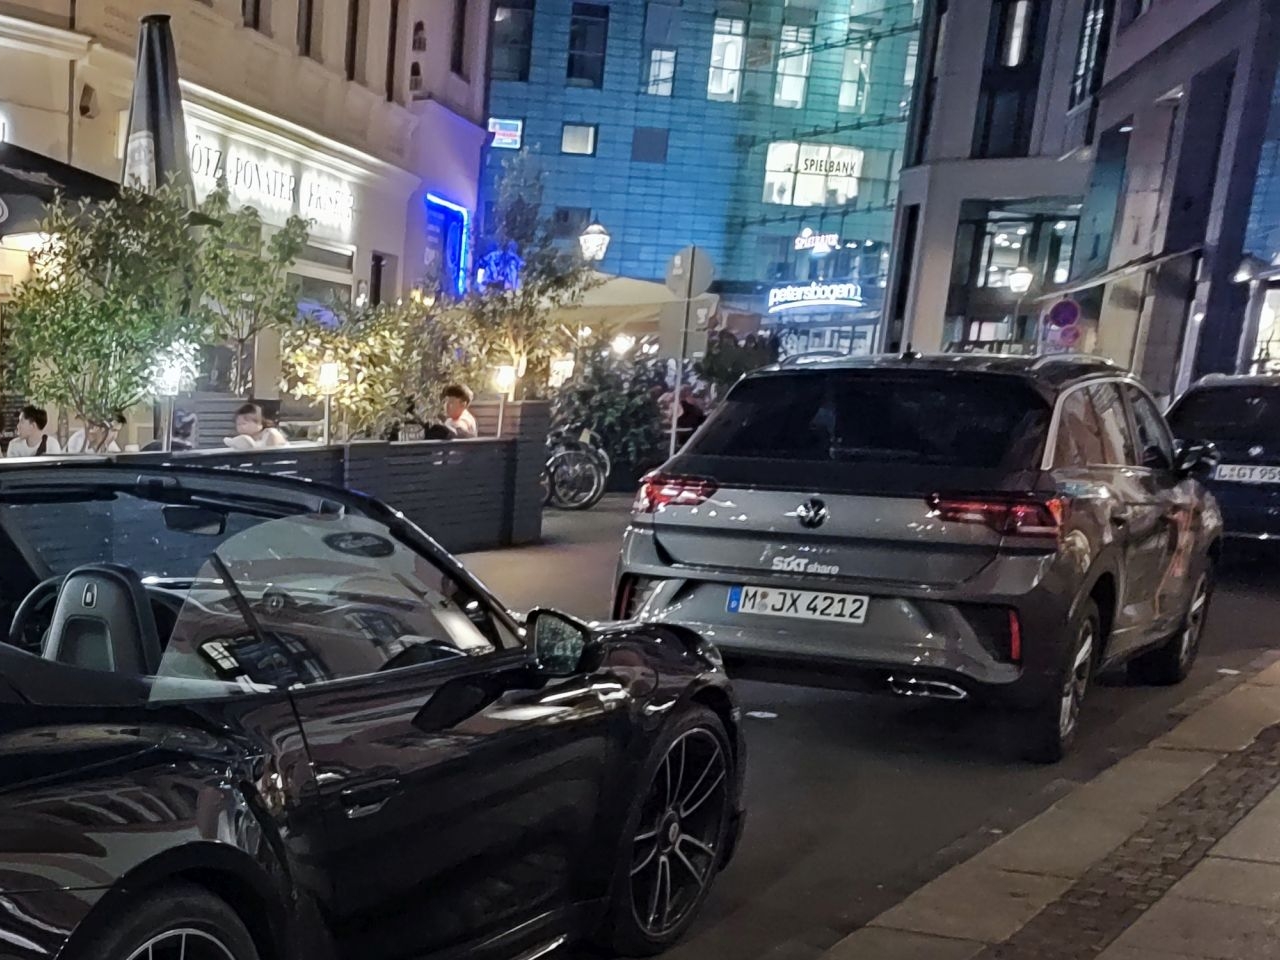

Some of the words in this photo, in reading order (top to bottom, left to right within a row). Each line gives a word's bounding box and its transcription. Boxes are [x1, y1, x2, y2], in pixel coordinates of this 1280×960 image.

[803, 158, 857, 175] SPIELBANK
[768, 281, 857, 307] petersbogen
[771, 555, 809, 573] SIXT
[806, 561, 840, 575] share
[741, 590, 759, 610] M
[771, 591, 803, 614] JX
[805, 594, 865, 620] 4212
